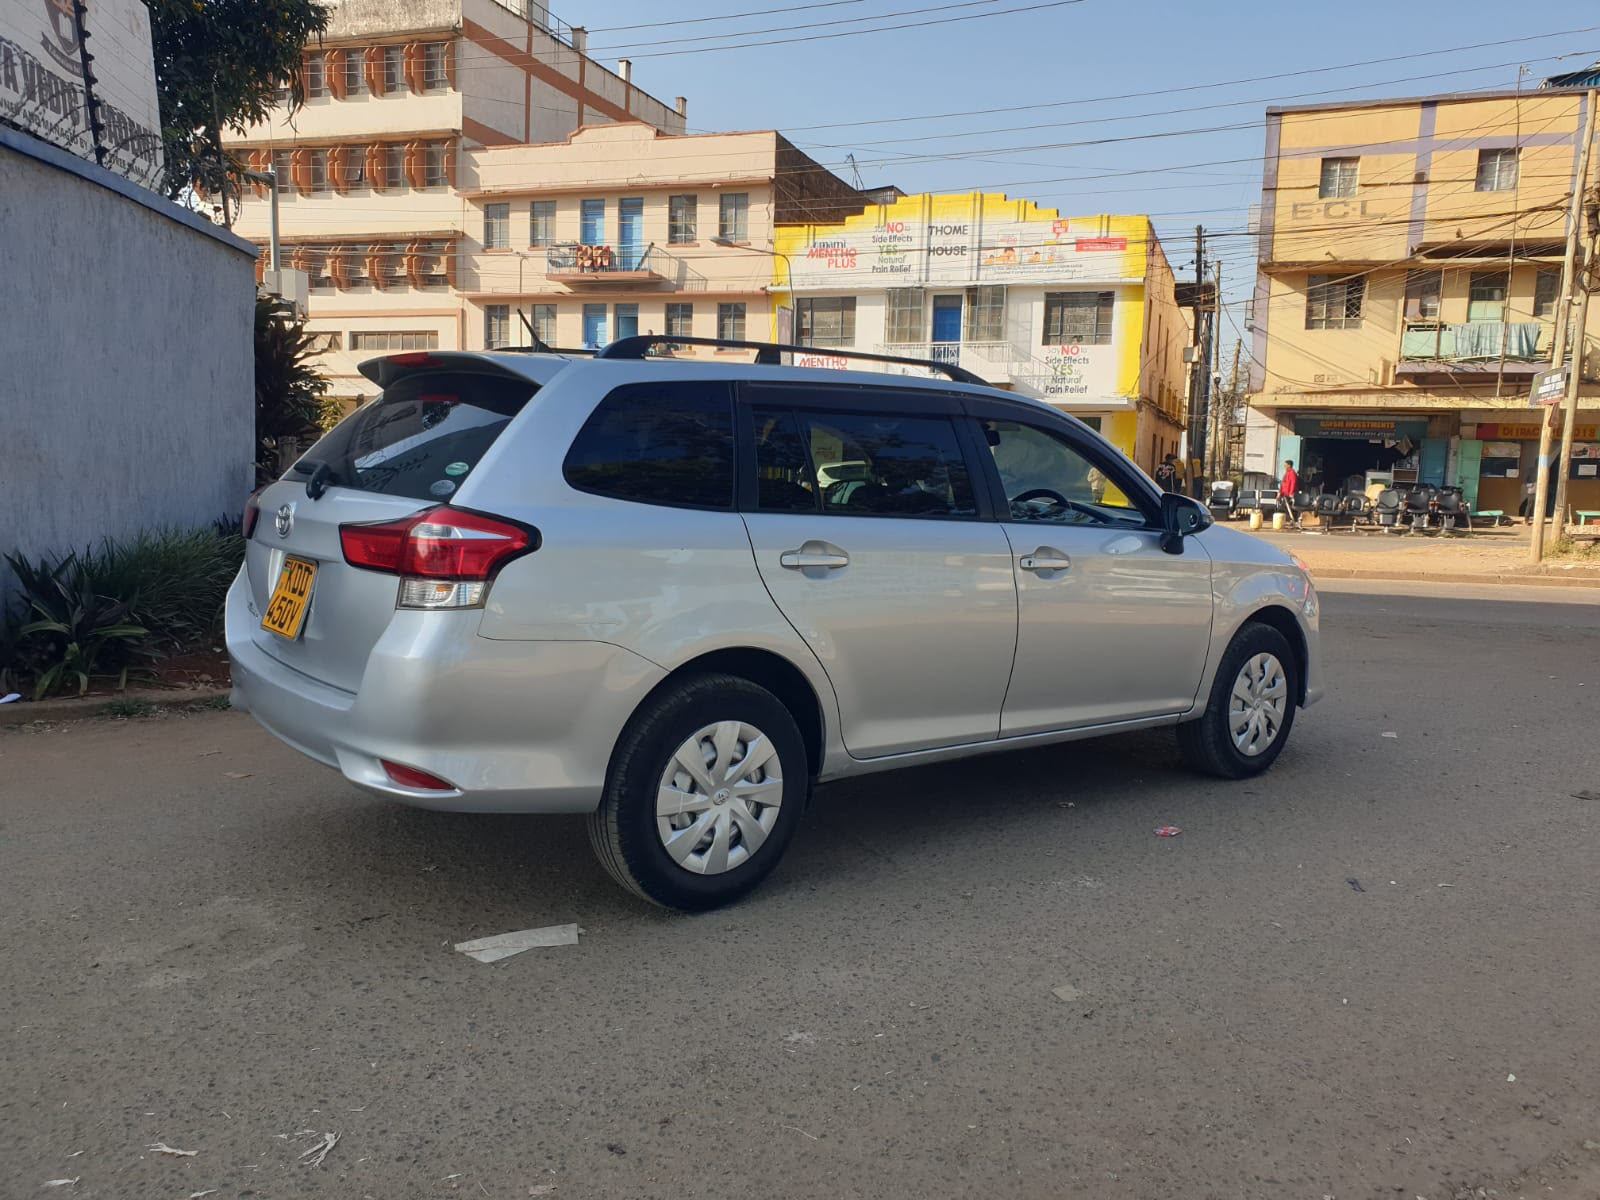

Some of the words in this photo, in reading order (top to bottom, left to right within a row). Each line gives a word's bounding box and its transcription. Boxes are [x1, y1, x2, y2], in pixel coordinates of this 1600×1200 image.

[886, 222, 904, 234] NO
[928, 225, 968, 235] THOME
[872, 235, 888, 243] Side
[889, 234, 912, 243] Effects
[806, 248, 857, 258] MENTHO
[879, 245, 897, 255] YES
[928, 246, 967, 256] HOUSE
[827, 258, 857, 268] PLUS
[878, 255, 906, 264] Natural
[872, 265, 888, 273] Pain
[890, 264, 911, 273] Relief
[1061, 345, 1080, 356] NO
[800, 357, 848, 367] MENTHO
[1045, 356, 1062, 365] Side
[1063, 356, 1089, 365] Effects
[1052, 364, 1073, 376] YES
[1051, 375, 1083, 384] Natural
[1045, 385, 1062, 394] Pain
[1064, 385, 1088, 394] Relief
[285, 562, 313, 598] KDD
[267, 594, 301, 632] 450Y
